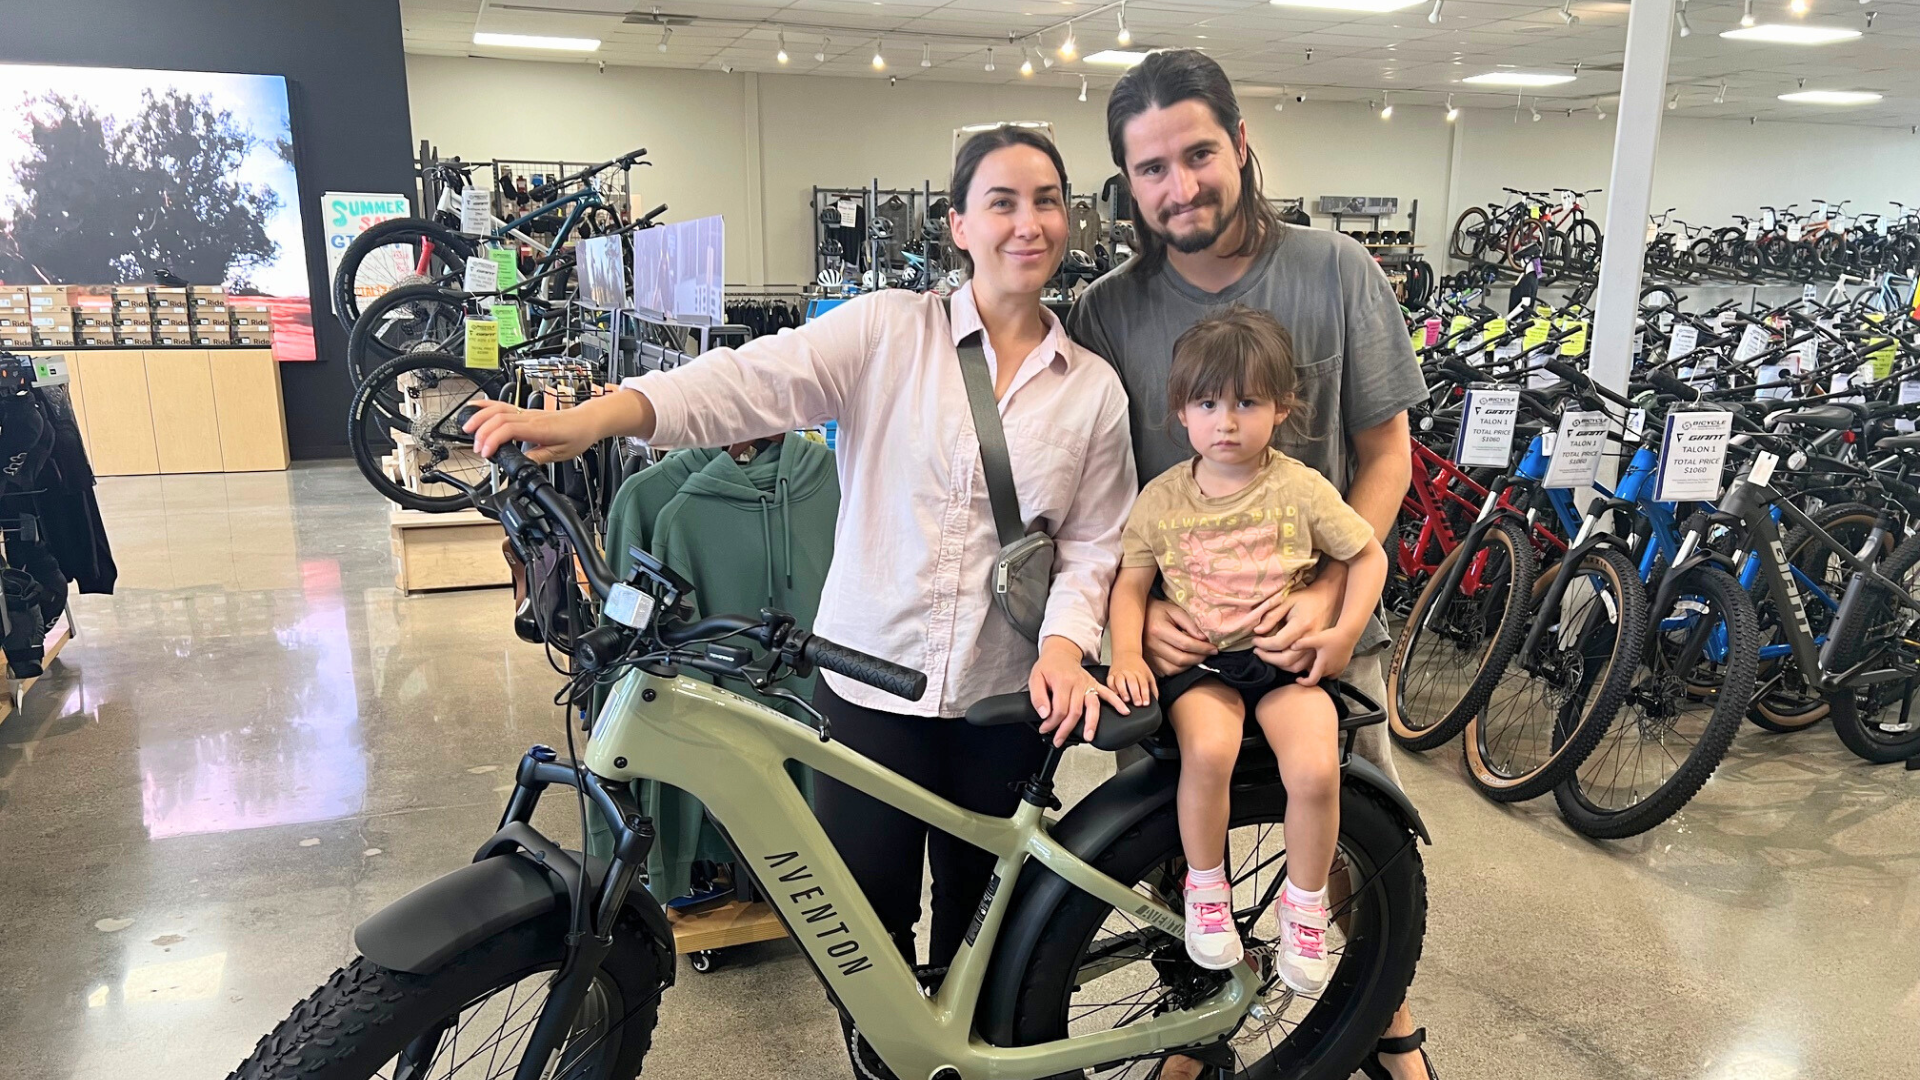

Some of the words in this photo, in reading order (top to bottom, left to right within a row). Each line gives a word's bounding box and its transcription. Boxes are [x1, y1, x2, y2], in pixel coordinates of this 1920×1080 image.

[332, 200, 405, 227] SUMMER
[1158, 515, 1238, 530] ALWAYS
[1769, 540, 1814, 641] GIANT
[764, 851, 874, 976] AVENTON
